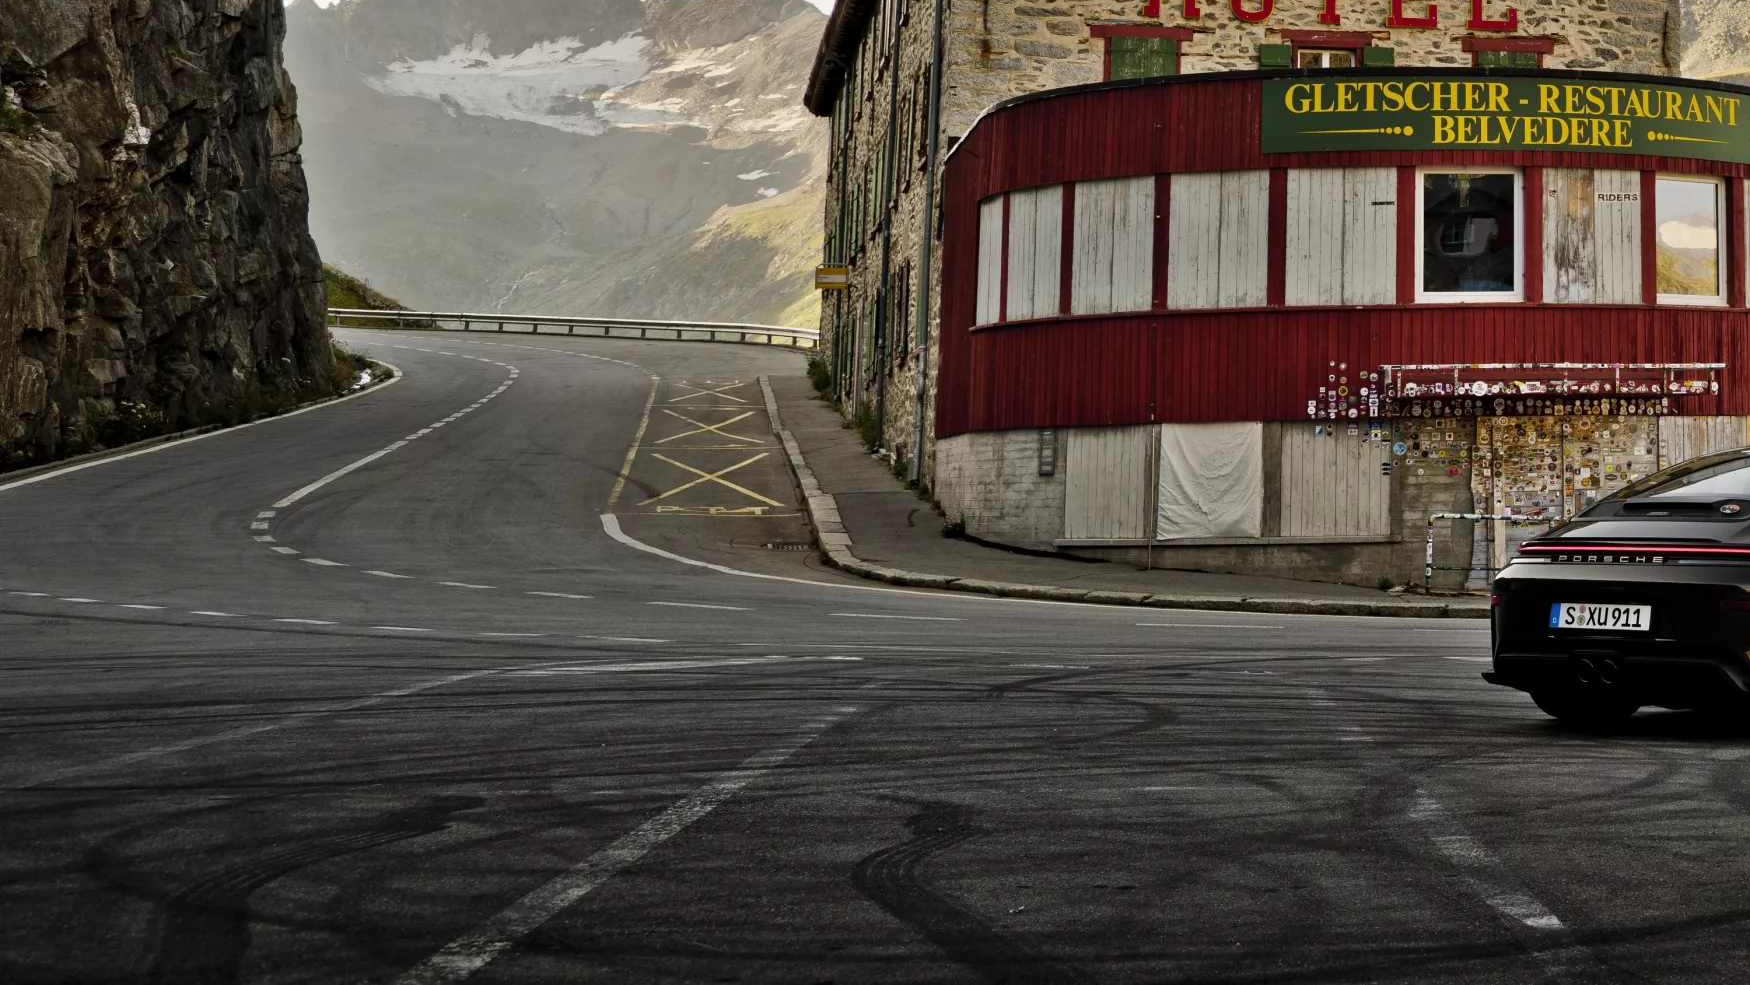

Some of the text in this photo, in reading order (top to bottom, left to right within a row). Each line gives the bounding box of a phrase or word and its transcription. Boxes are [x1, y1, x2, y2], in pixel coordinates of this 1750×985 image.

[1284, 81, 1511, 114] GLETSCHER
[1537, 84, 1741, 126] RESTAURANT
[1431, 115, 1633, 148] BELVEDERE
[1597, 193, 1638, 202] RIDERS
[1558, 555, 1664, 563] PORSCHE
